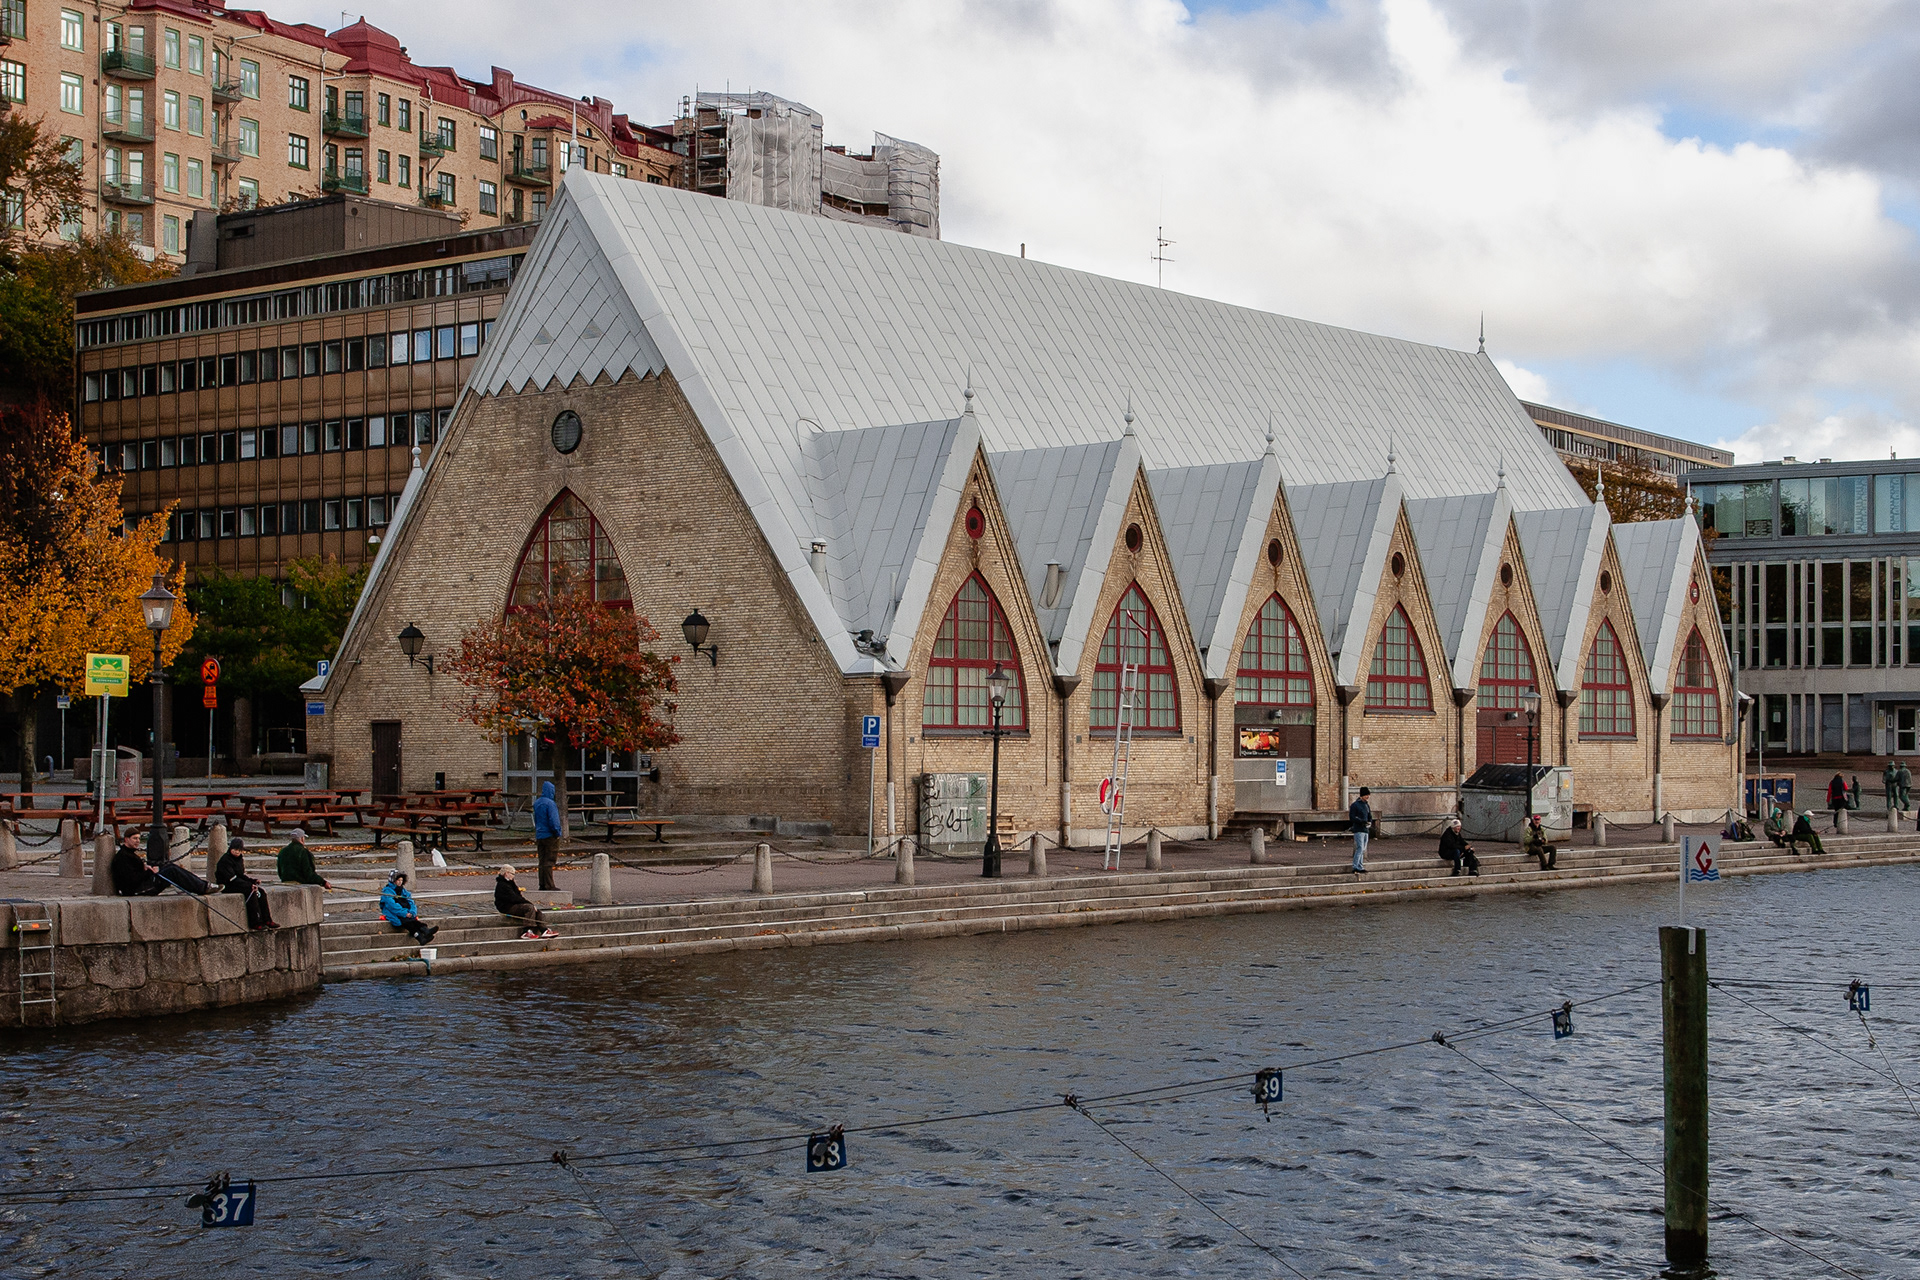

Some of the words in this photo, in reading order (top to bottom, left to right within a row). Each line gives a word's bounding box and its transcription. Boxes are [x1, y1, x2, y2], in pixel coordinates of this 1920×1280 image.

[321, 662, 327, 676] P
[868, 718, 876, 734] P
[211, 1192, 250, 1222] 37
